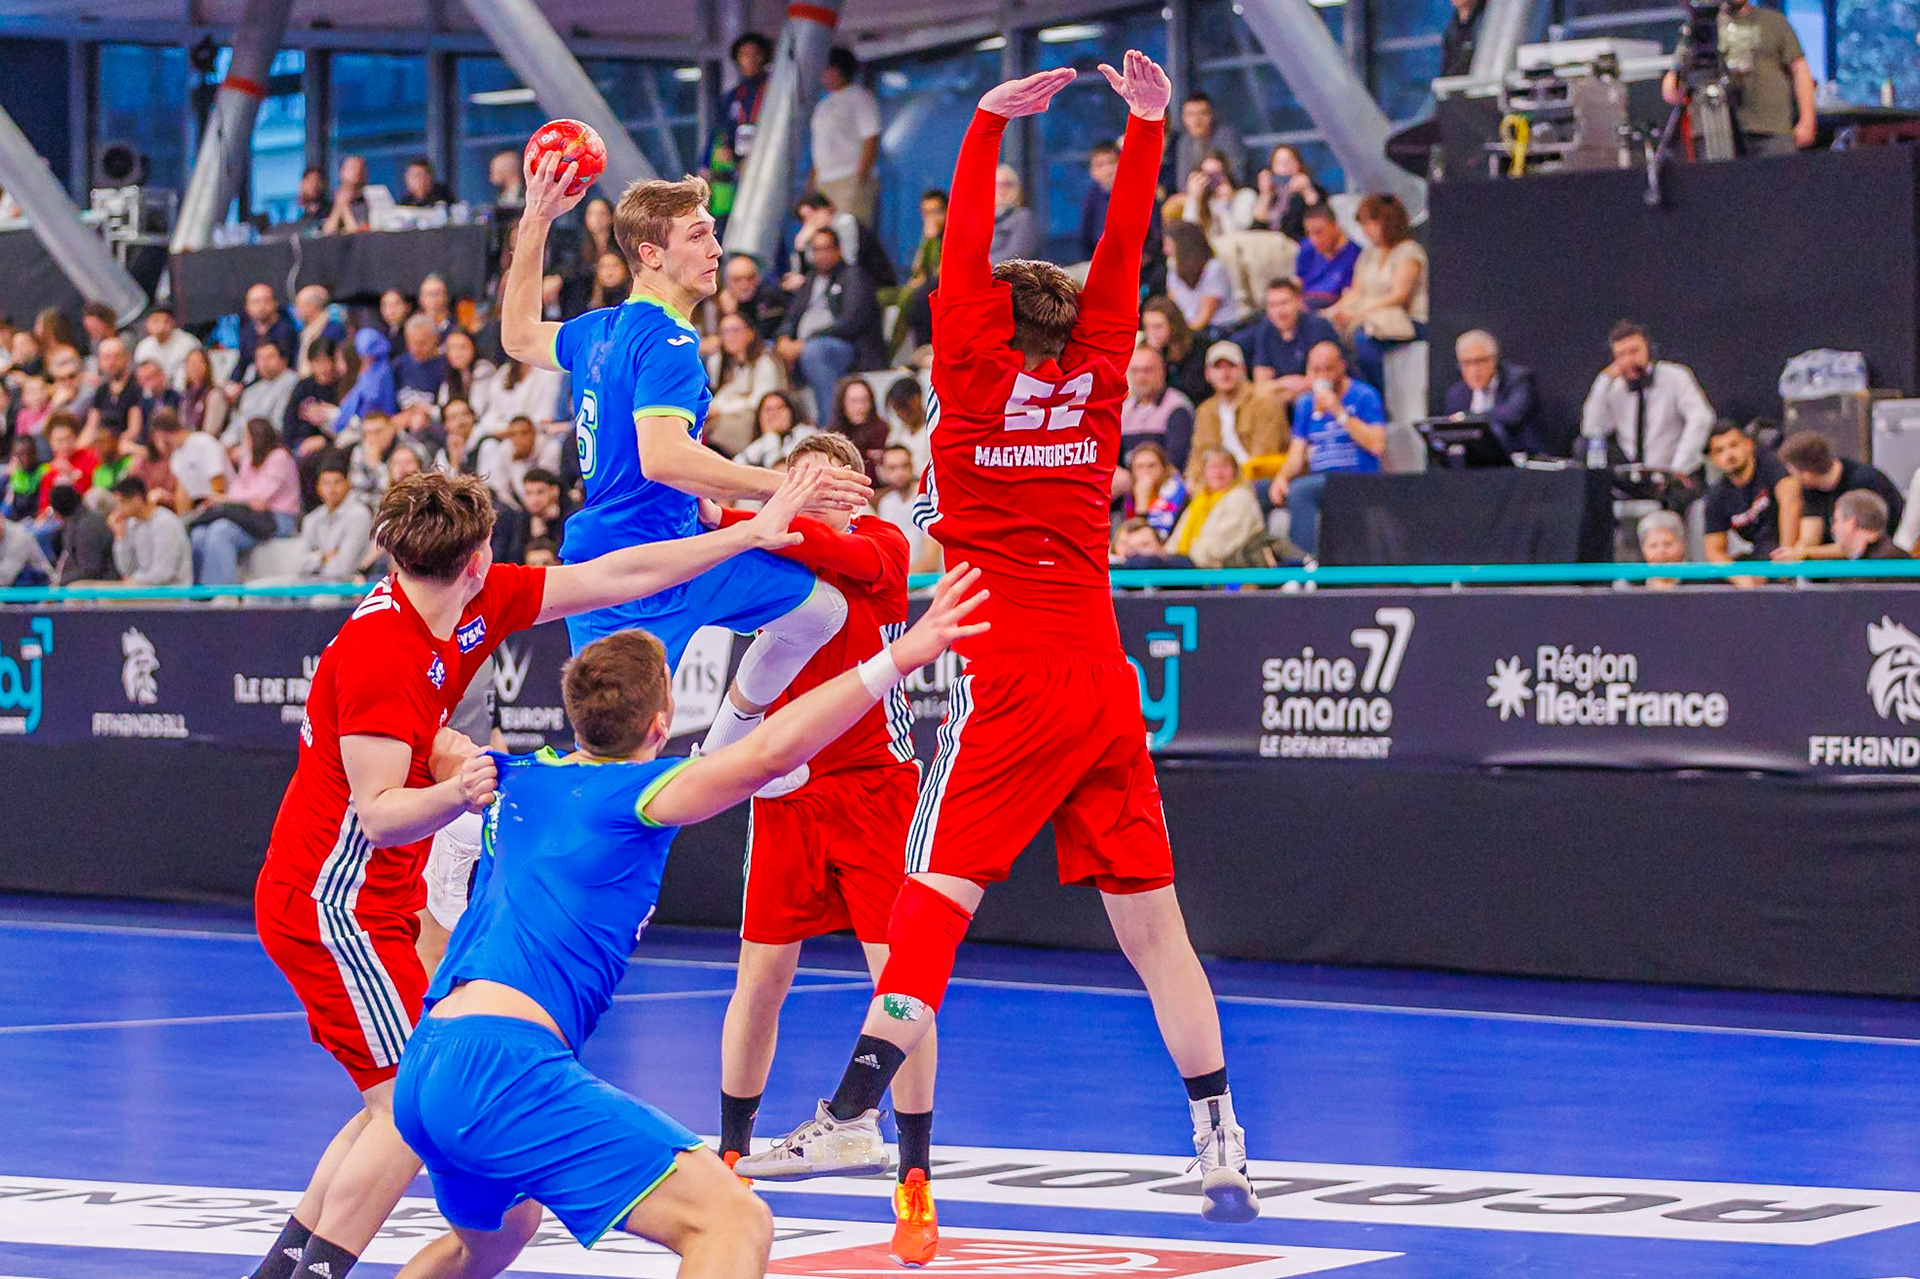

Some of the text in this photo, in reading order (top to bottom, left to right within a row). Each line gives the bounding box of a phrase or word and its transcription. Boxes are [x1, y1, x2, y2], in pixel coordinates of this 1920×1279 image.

[1004, 372, 1094, 432] 52
[974, 436, 1098, 468] MAGYARORSZÁG
[1261, 645, 1357, 693] seine
[1350, 606, 1415, 693] 77
[1536, 644, 1638, 692] Région
